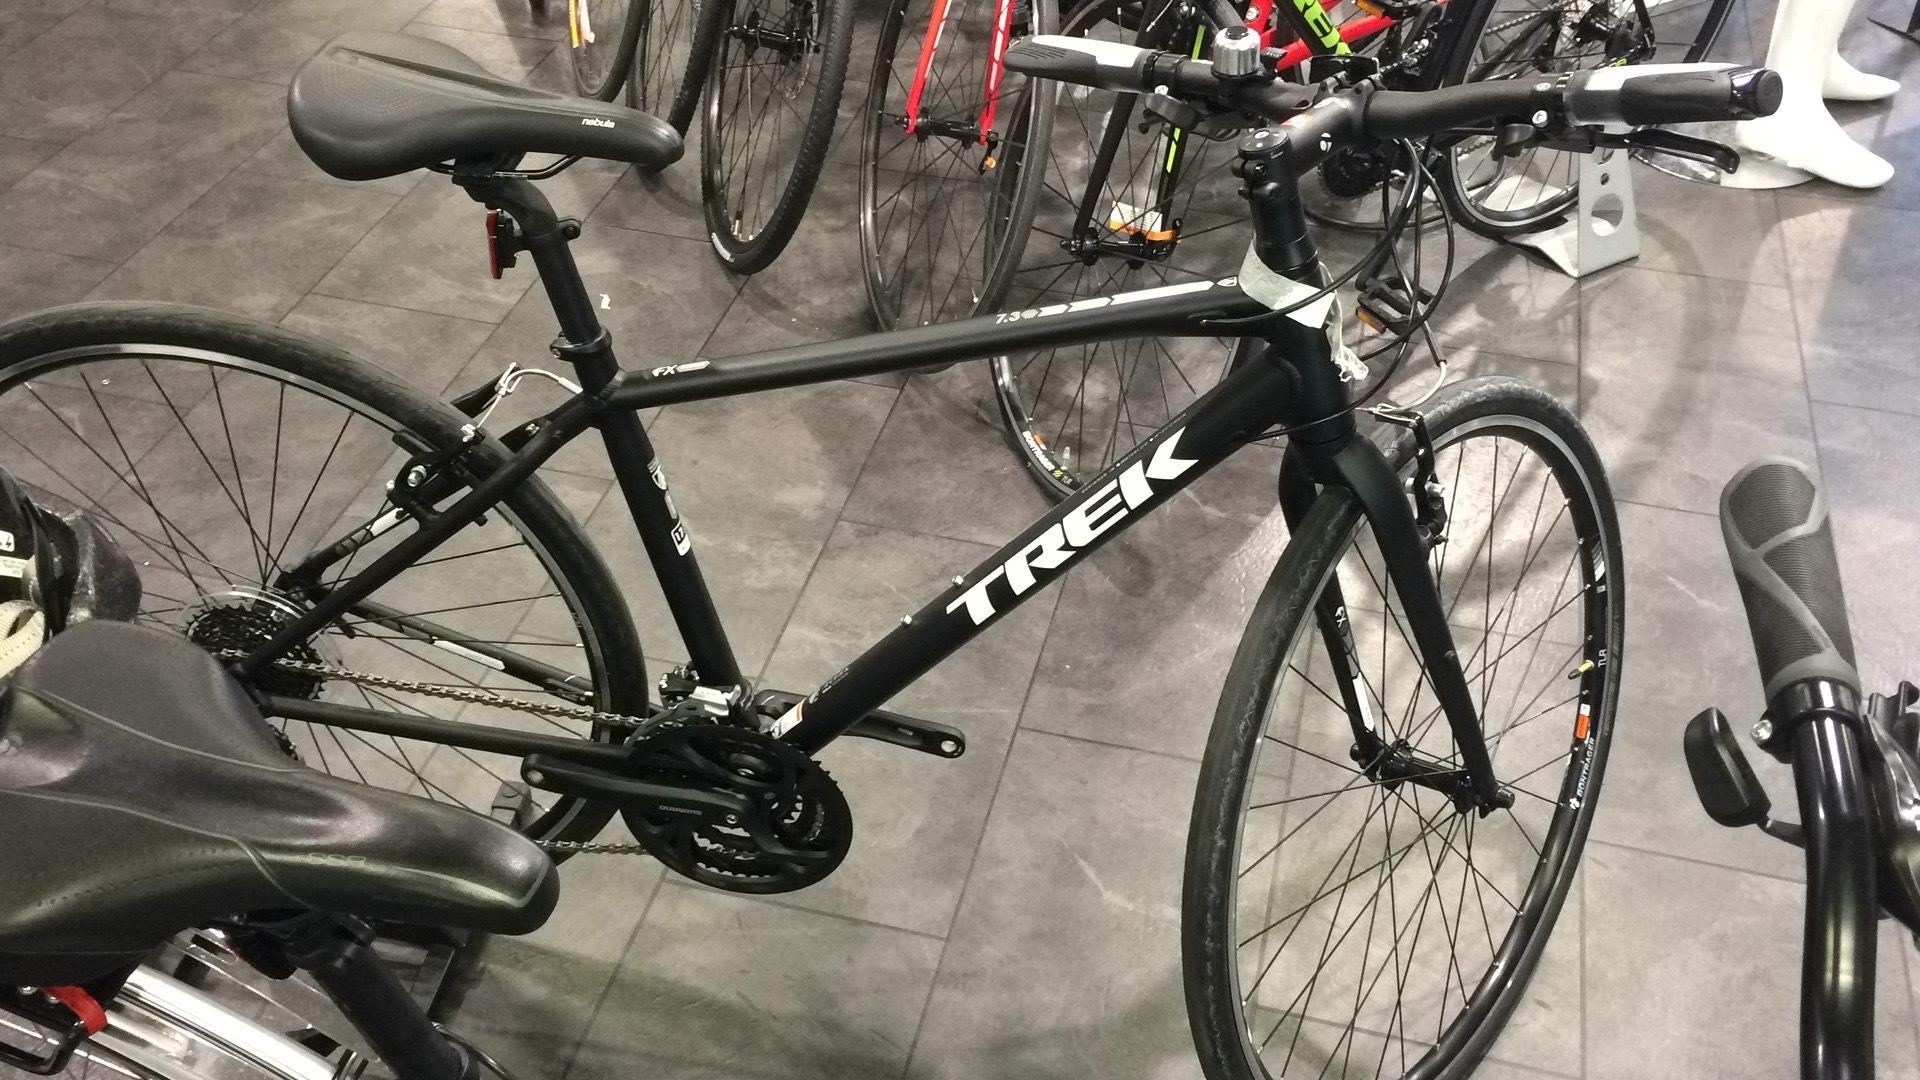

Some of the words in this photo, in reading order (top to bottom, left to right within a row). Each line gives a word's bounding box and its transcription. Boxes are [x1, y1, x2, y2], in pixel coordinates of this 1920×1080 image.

[995, 311, 1021, 325] 7.3
[652, 364, 678, 377] FX
[946, 426, 1199, 625] TREK
[1576, 737, 1596, 798] BONTRAGER
